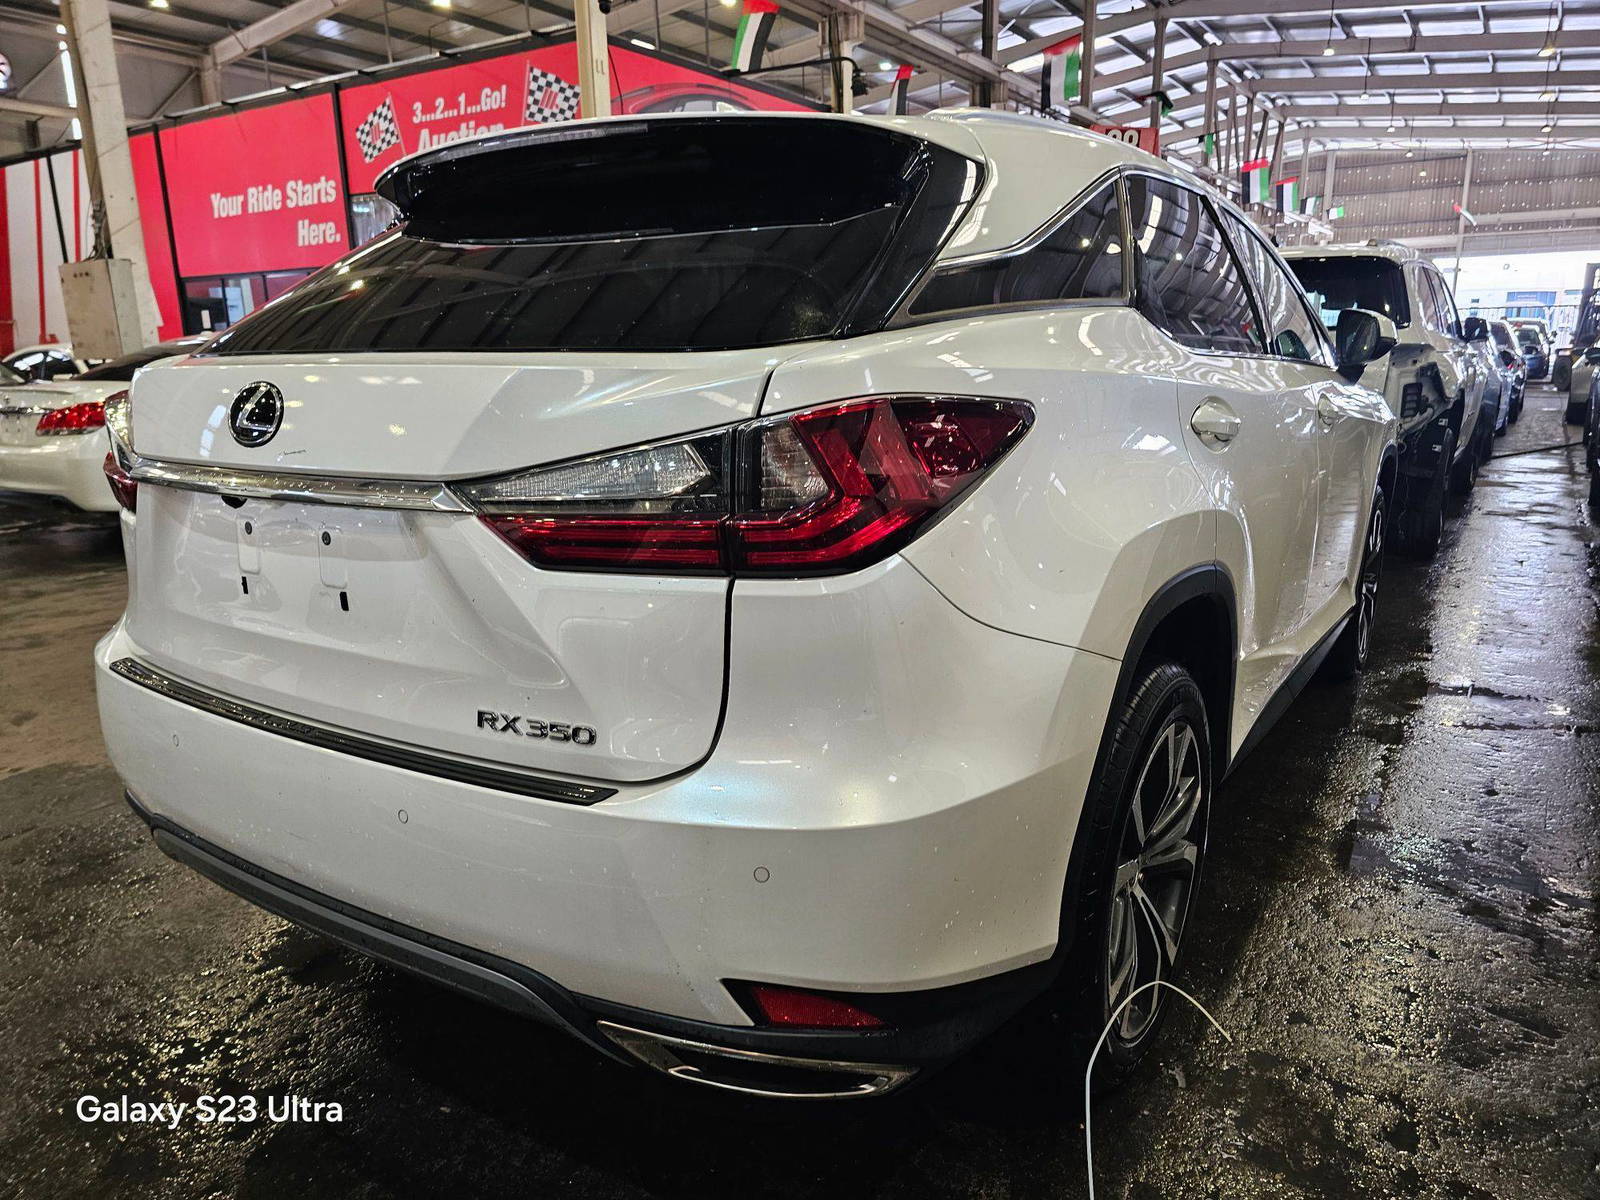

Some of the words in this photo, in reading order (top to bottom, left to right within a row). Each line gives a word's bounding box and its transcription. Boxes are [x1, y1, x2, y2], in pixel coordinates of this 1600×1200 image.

[210, 192, 245, 219] Your
[247, 184, 282, 214] Ride
[286, 176, 337, 208] Starts
[298, 219, 341, 247] Here.
